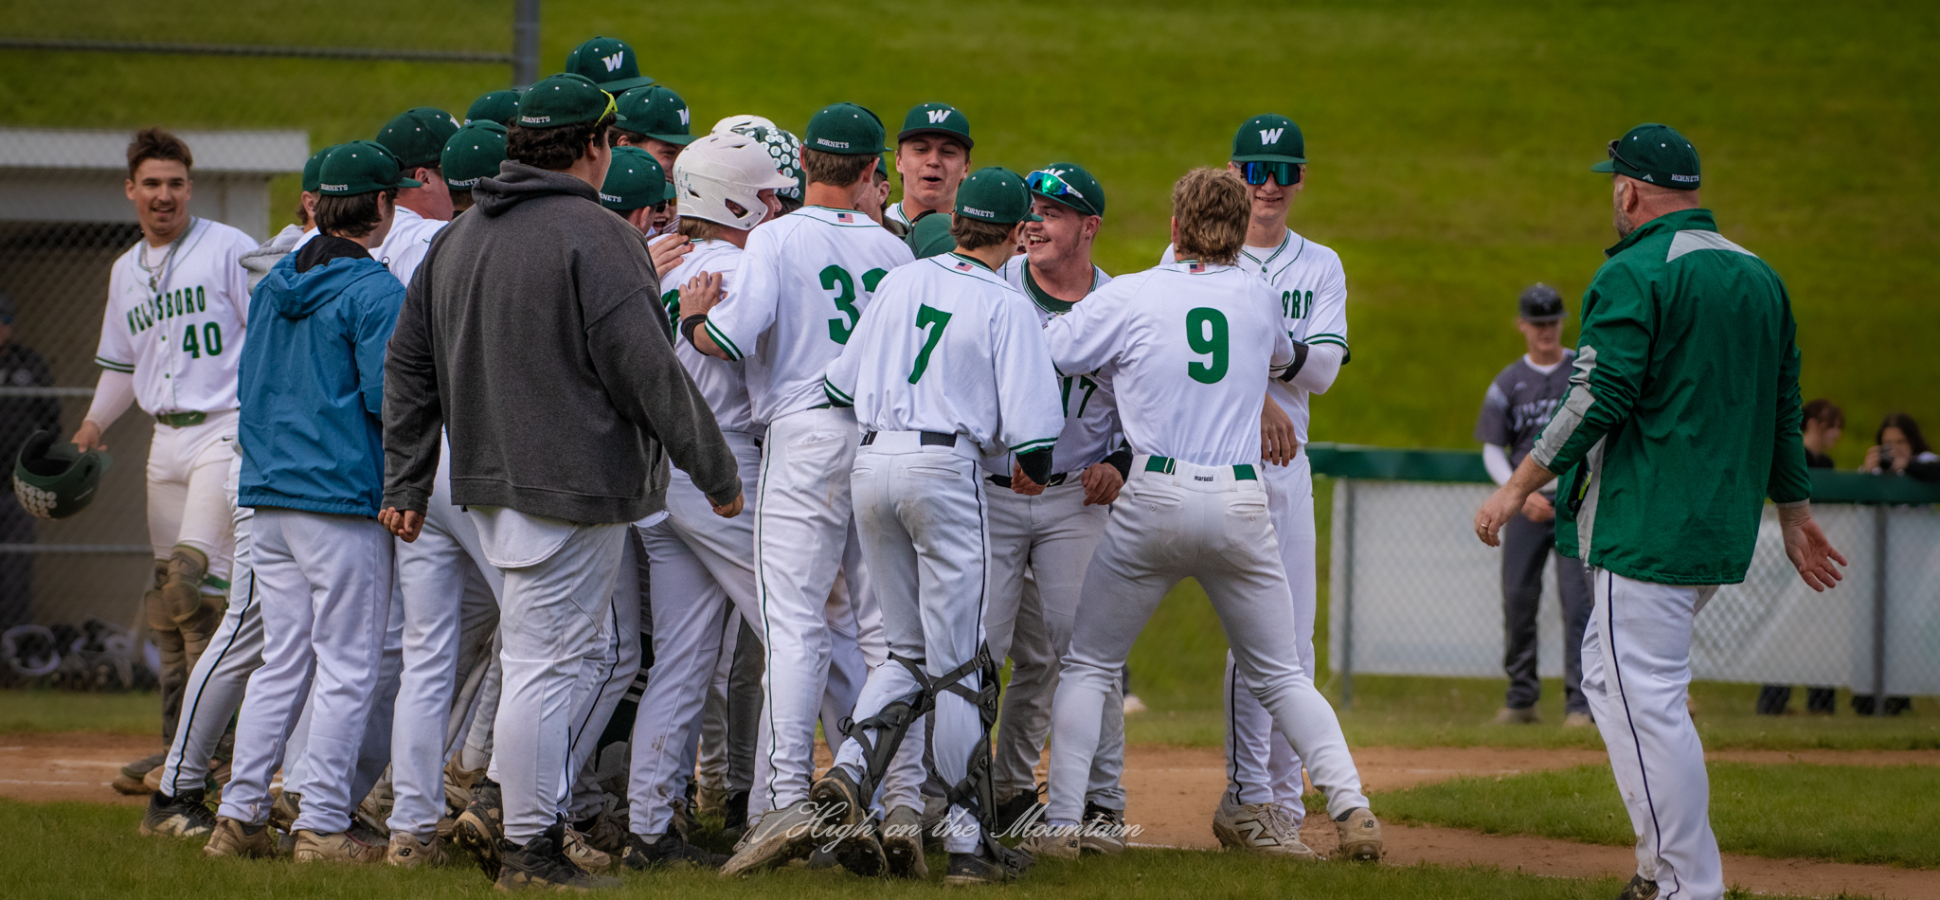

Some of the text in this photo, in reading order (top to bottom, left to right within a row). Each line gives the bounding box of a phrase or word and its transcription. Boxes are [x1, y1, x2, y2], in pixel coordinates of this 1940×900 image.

[601, 50, 624, 73] W
[521, 115, 551, 124] HORNETS
[926, 109, 951, 124] W
[817, 137, 850, 149] HORNETS
[1259, 127, 1284, 145] W
[1671, 173, 1700, 183] HORNETS
[320, 182, 349, 191] HORNETS
[963, 205, 995, 218] HORNETS
[182, 321, 223, 360] 40
[907, 302, 953, 386] 7
[1185, 306, 1230, 385] 9
[1062, 374, 1099, 419] 17
